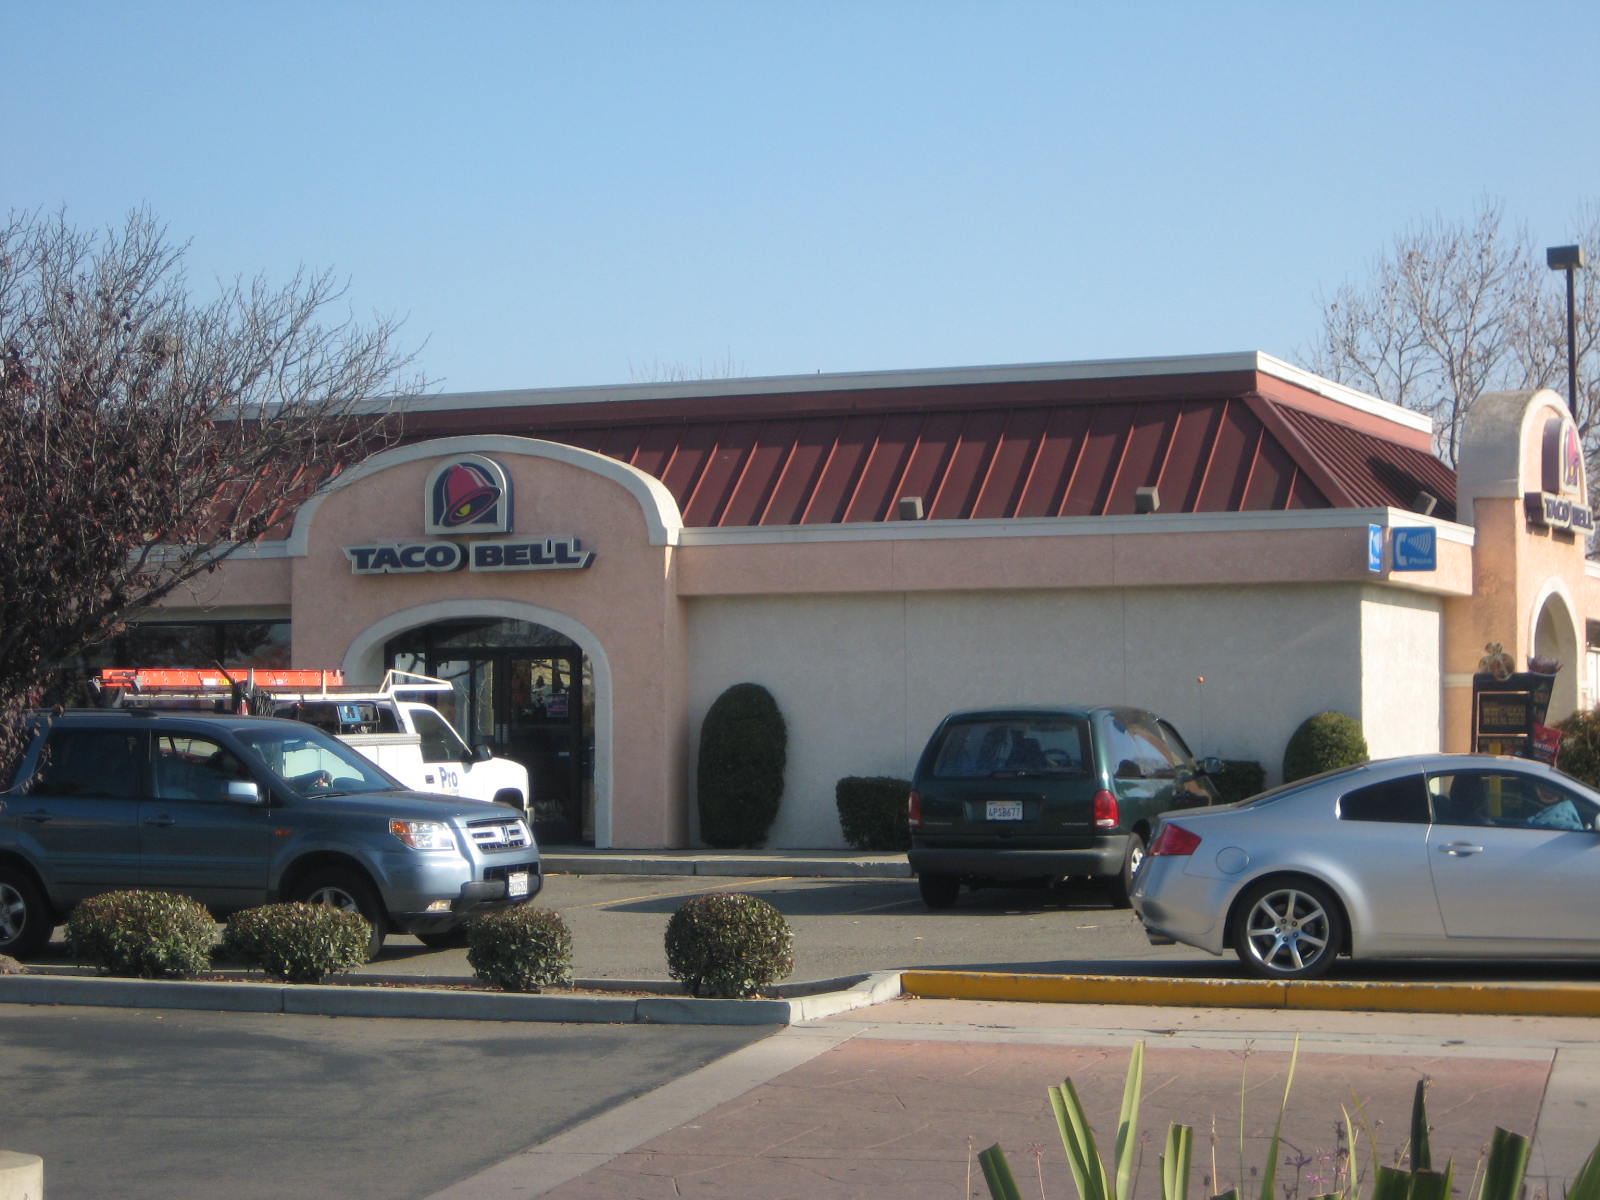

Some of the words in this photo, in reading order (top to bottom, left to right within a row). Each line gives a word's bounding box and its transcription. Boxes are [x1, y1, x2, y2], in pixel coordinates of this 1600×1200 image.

[1544, 498, 1570, 521] TACO
[350, 545, 457, 569] TACO
[474, 541, 581, 567] BELL
[438, 766, 458, 788] Pro
